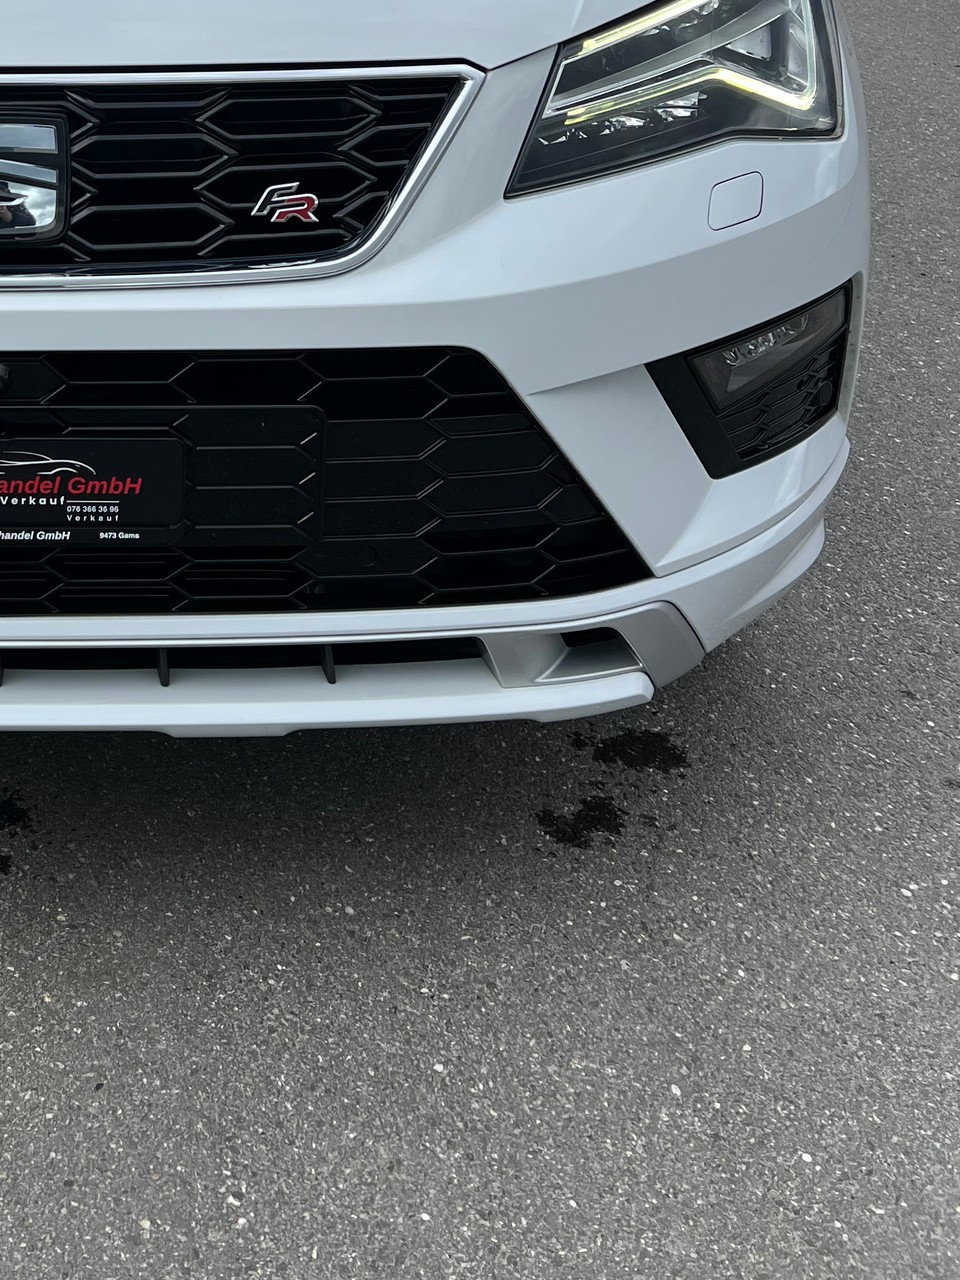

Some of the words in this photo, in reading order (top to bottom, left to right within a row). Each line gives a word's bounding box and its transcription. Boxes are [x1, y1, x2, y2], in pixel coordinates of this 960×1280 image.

[250, 181, 320, 223] FR
[67, 476, 143, 495] GmbH
[0, 496, 66, 505] Verkauf
[36, 531, 71, 540] GmbH
